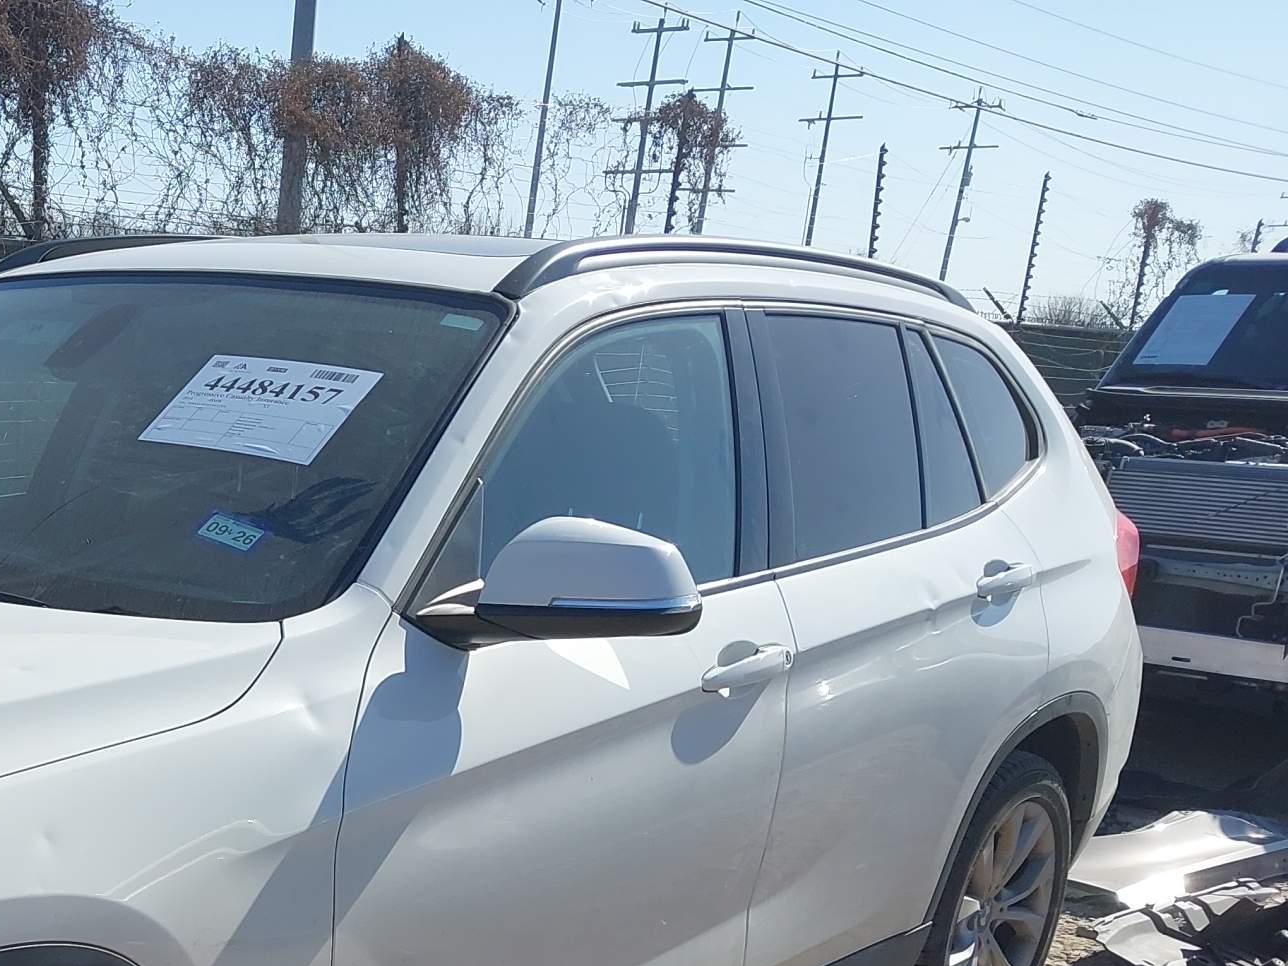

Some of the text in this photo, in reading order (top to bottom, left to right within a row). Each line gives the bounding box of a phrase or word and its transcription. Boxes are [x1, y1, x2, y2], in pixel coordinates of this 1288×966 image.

[203, 374, 345, 406] 44484157
[206, 521, 257, 546] 09 26
